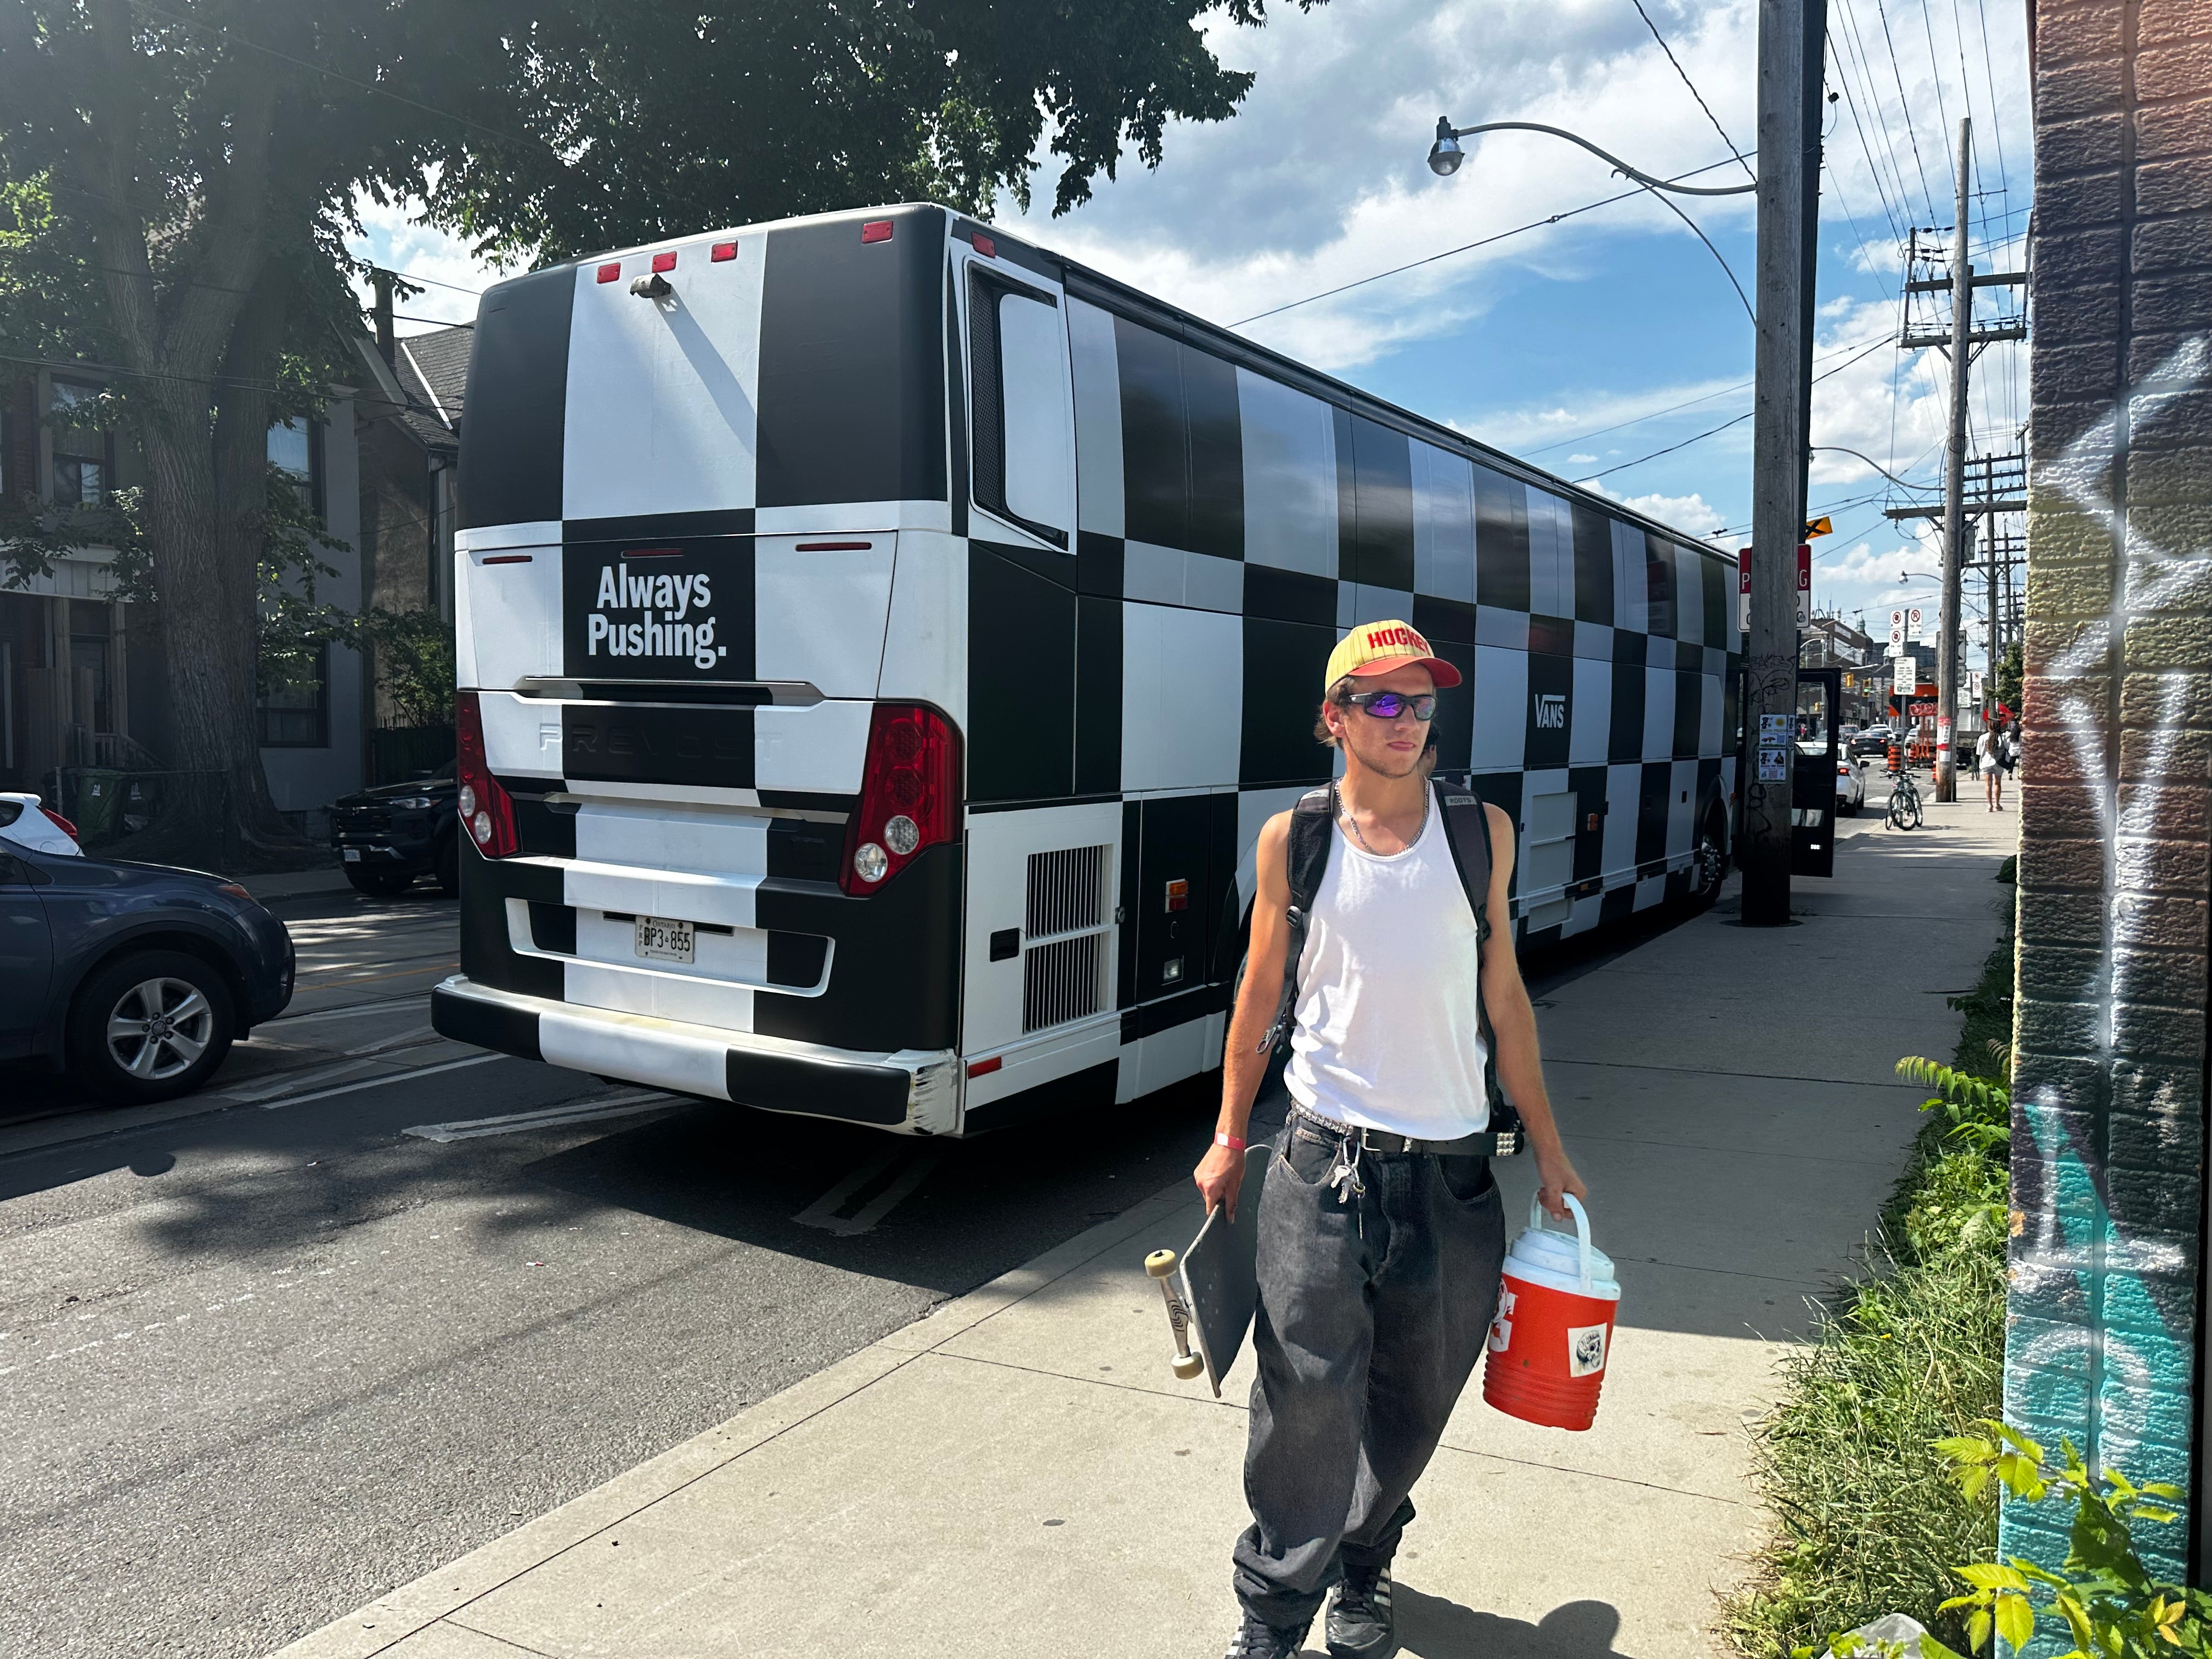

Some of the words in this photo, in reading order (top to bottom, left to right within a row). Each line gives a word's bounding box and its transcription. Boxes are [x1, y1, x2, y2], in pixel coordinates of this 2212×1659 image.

[596, 563, 712, 620] Always
[588, 610, 727, 669] Pushing.
[1367, 627, 1431, 657] HOCKEY
[1534, 693, 1566, 729] VANS
[652, 920, 676, 929] ONTARIO
